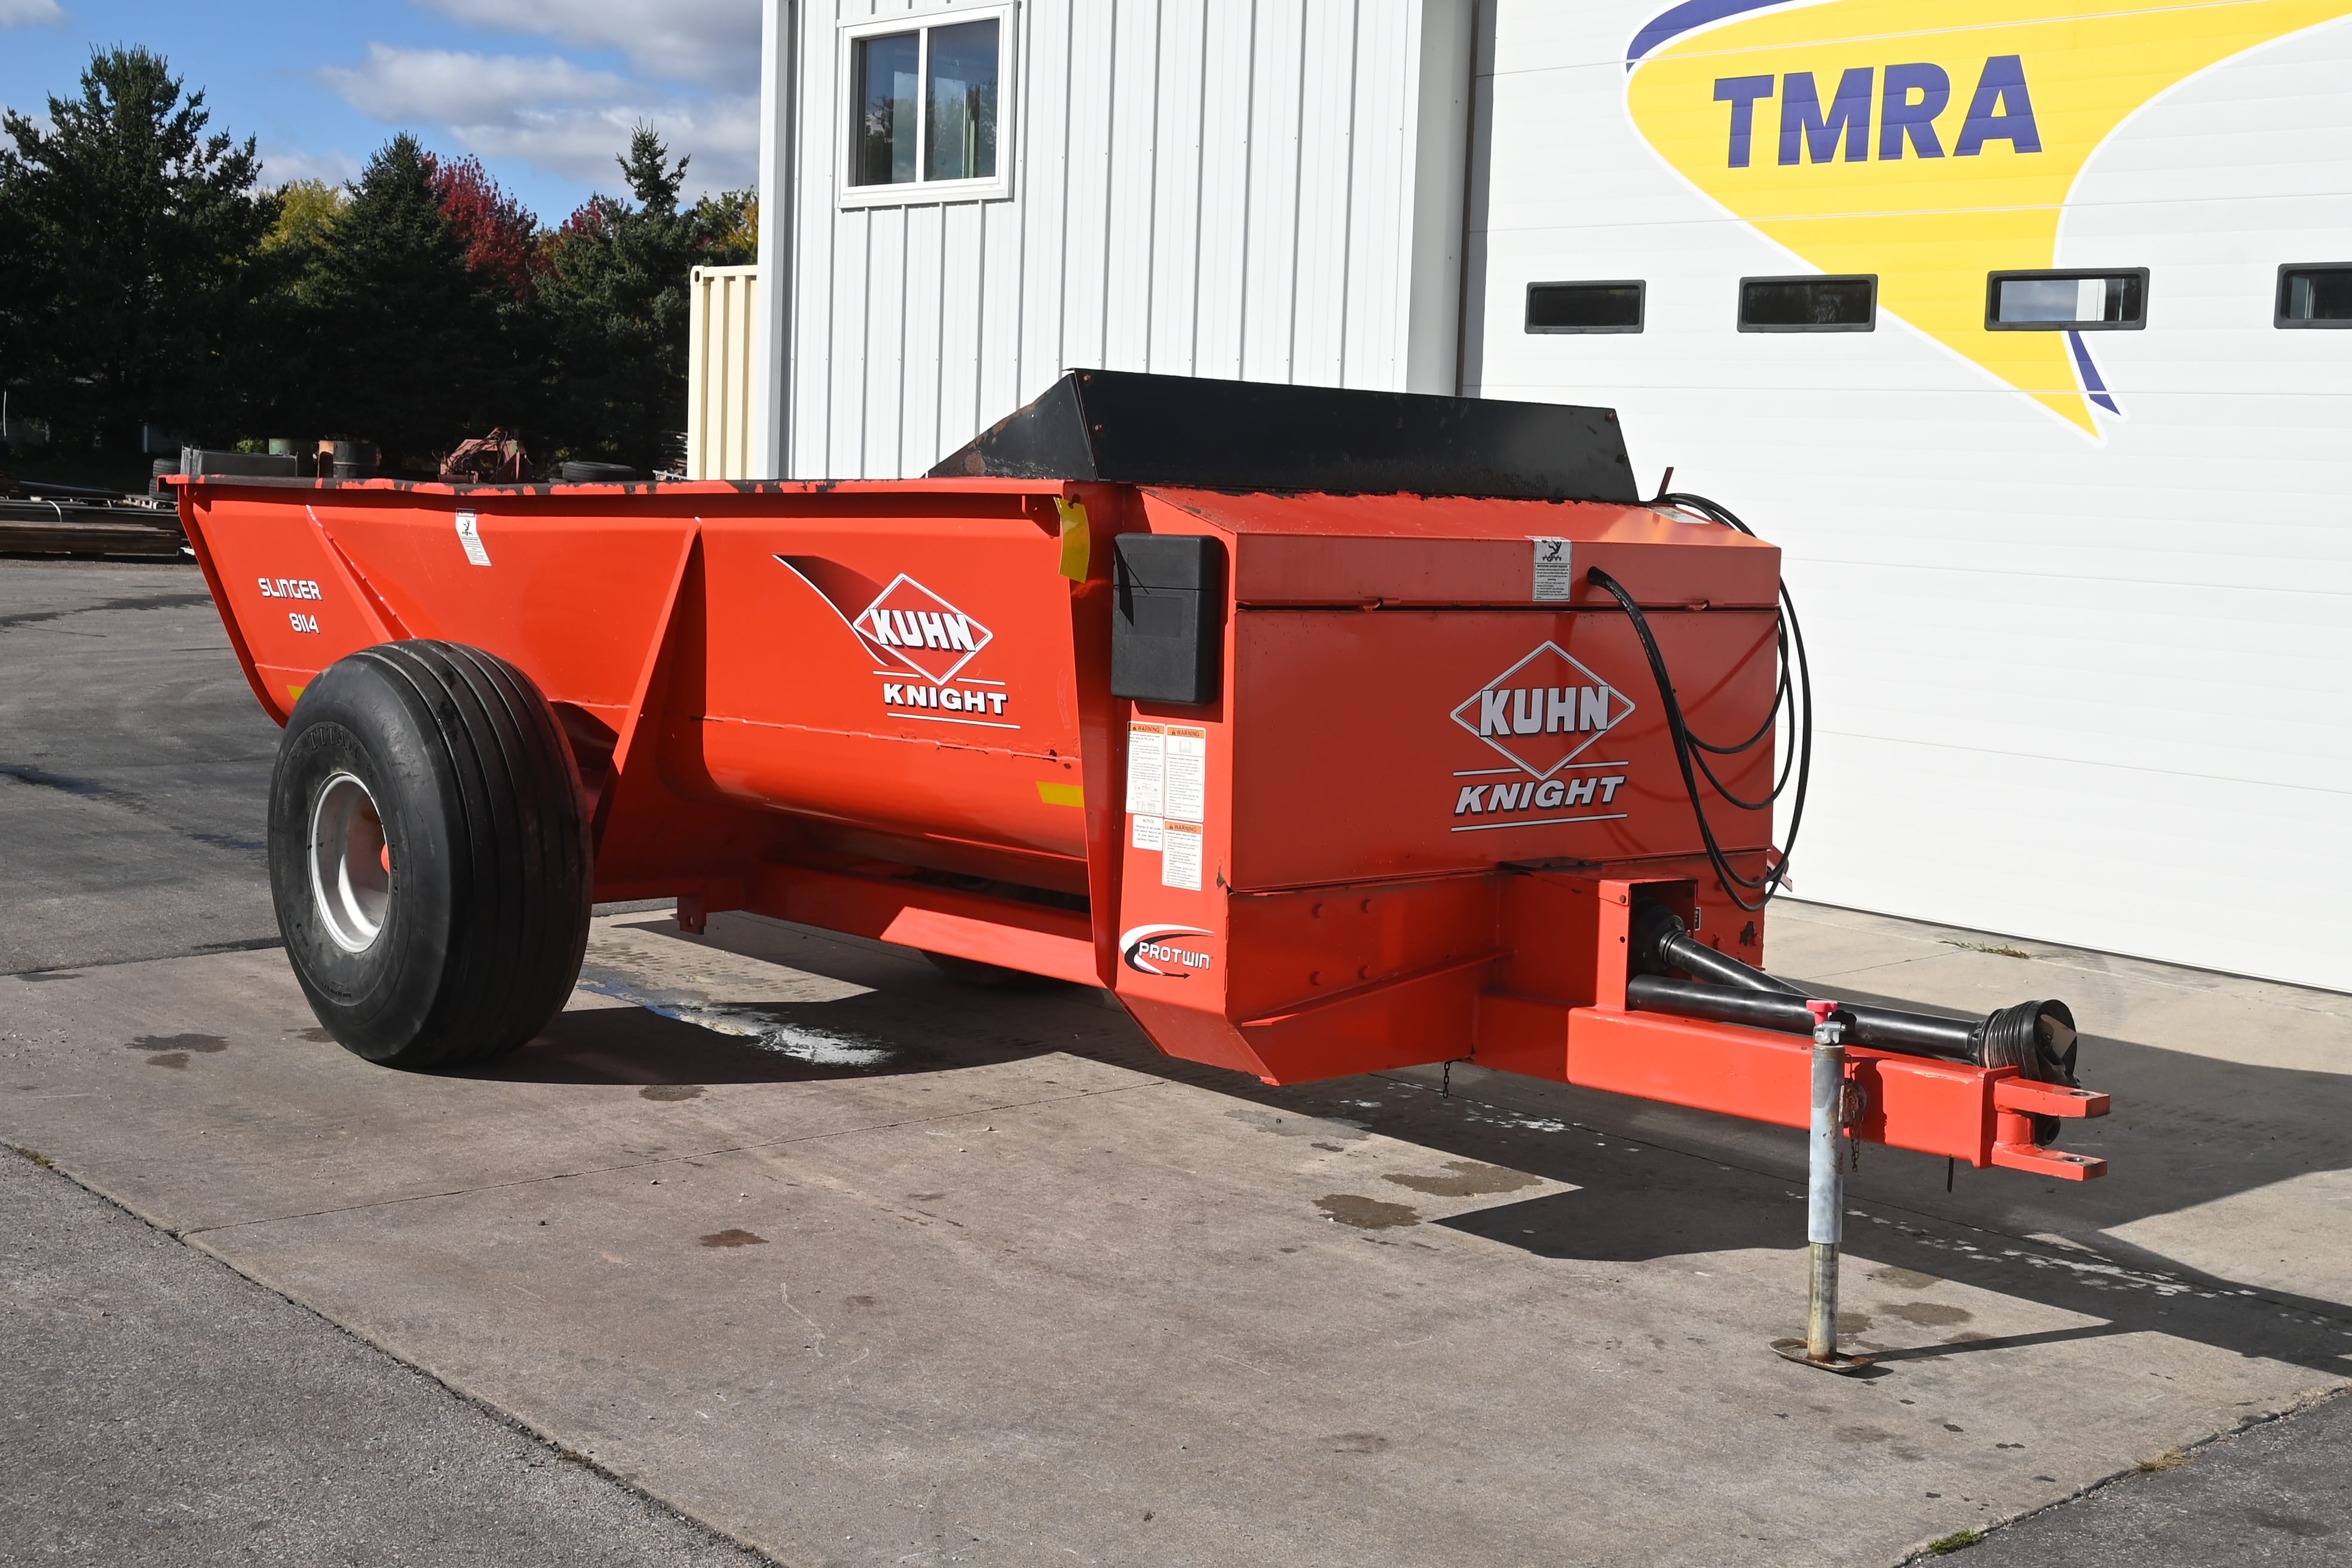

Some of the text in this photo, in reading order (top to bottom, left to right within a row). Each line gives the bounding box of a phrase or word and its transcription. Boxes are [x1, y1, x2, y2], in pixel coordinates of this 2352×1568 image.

[1713, 54, 2042, 168] TMRA
[258, 578, 323, 601] SLINGER
[289, 612, 320, 634] 8114
[868, 608, 976, 651] KUHN
[883, 682, 1008, 715] KNIGHT
[1479, 685, 1609, 737] KUHN
[307, 726, 360, 760] TITAN
[1453, 775, 1626, 815] KNIGHT
[1174, 824, 1197, 832] WARNING
[1138, 941, 1210, 970] PROTWIN
